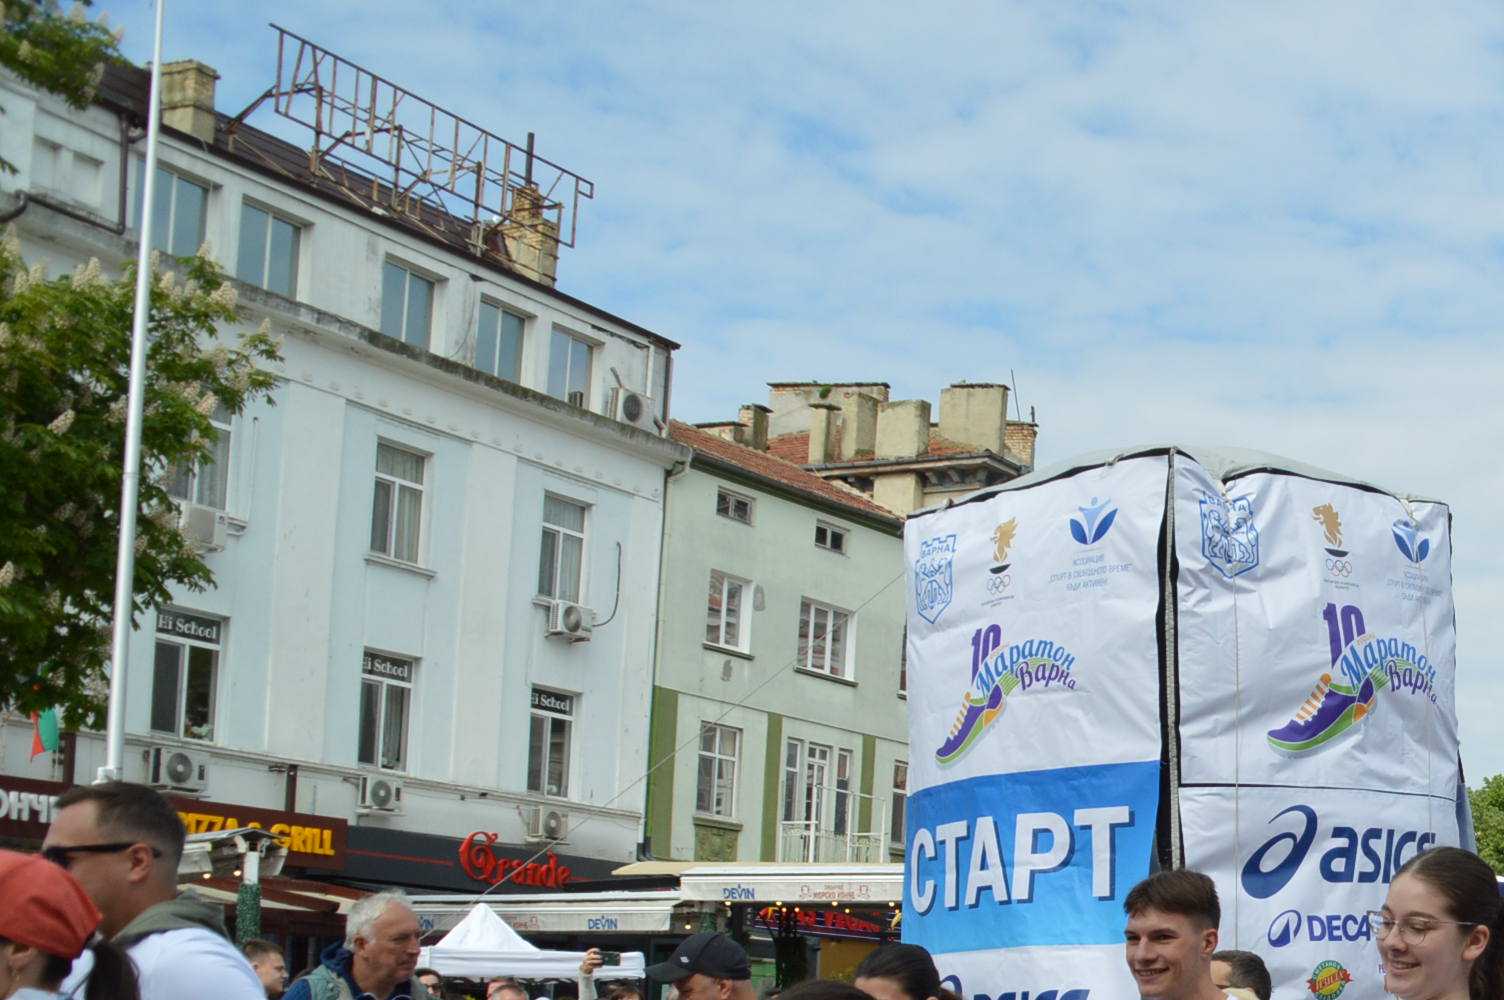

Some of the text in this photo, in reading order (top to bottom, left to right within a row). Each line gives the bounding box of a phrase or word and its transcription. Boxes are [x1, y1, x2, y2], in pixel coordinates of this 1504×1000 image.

[158, 614, 217, 640] Hi School
[1323, 602, 1366, 669] 10
[373, 658, 408, 678] School
[971, 624, 1002, 686] 10
[975, 638, 1076, 699] Маратон
[1340, 638, 1437, 693] Маратон
[1015, 661, 1077, 691] Варна
[1385, 659, 1438, 703] Варна
[540, 694, 570, 712] School
[270, 823, 336, 856] GRILL
[459, 831, 572, 888] Grande
[910, 805, 1134, 916] СТАРТ
[723, 883, 755, 899] DEVIN
[588, 915, 618, 929] DEVIN
[1307, 914, 1371, 942] DECA
